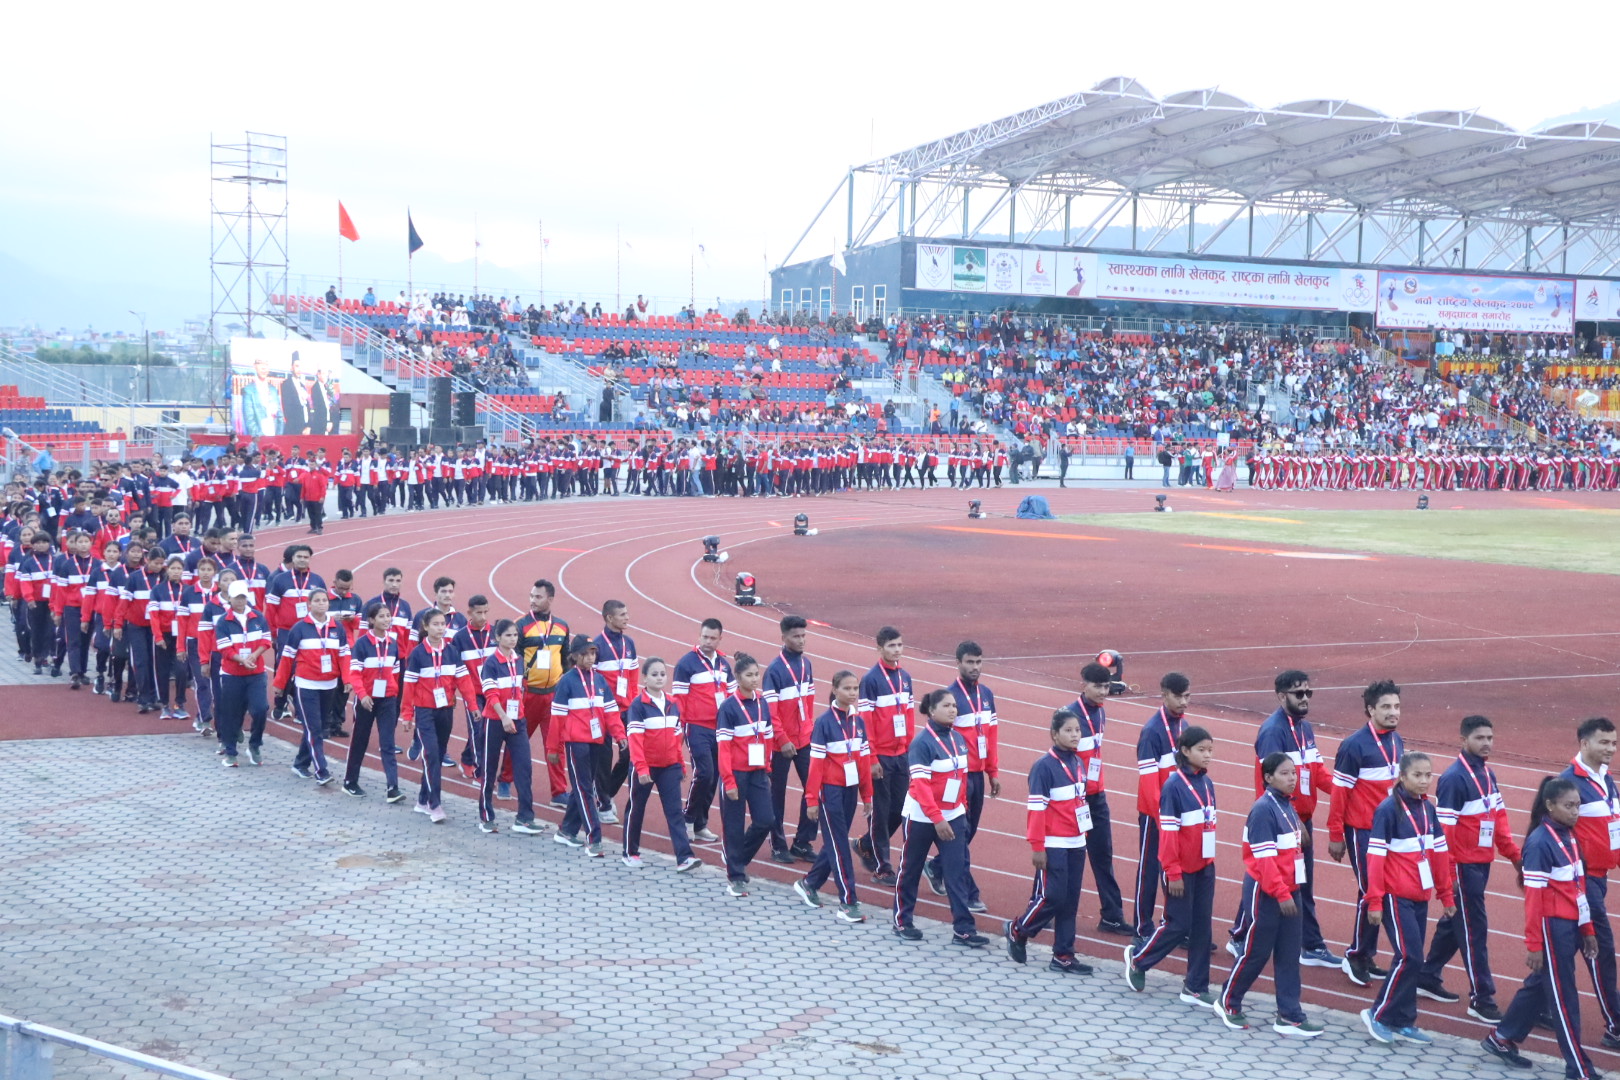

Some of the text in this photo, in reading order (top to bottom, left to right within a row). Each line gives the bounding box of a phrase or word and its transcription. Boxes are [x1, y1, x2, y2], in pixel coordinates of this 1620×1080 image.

[1161, 264, 1185, 279] लागि
[1267, 270, 1290, 285] लागि
[1294, 272, 1330, 289] खेलकुद
